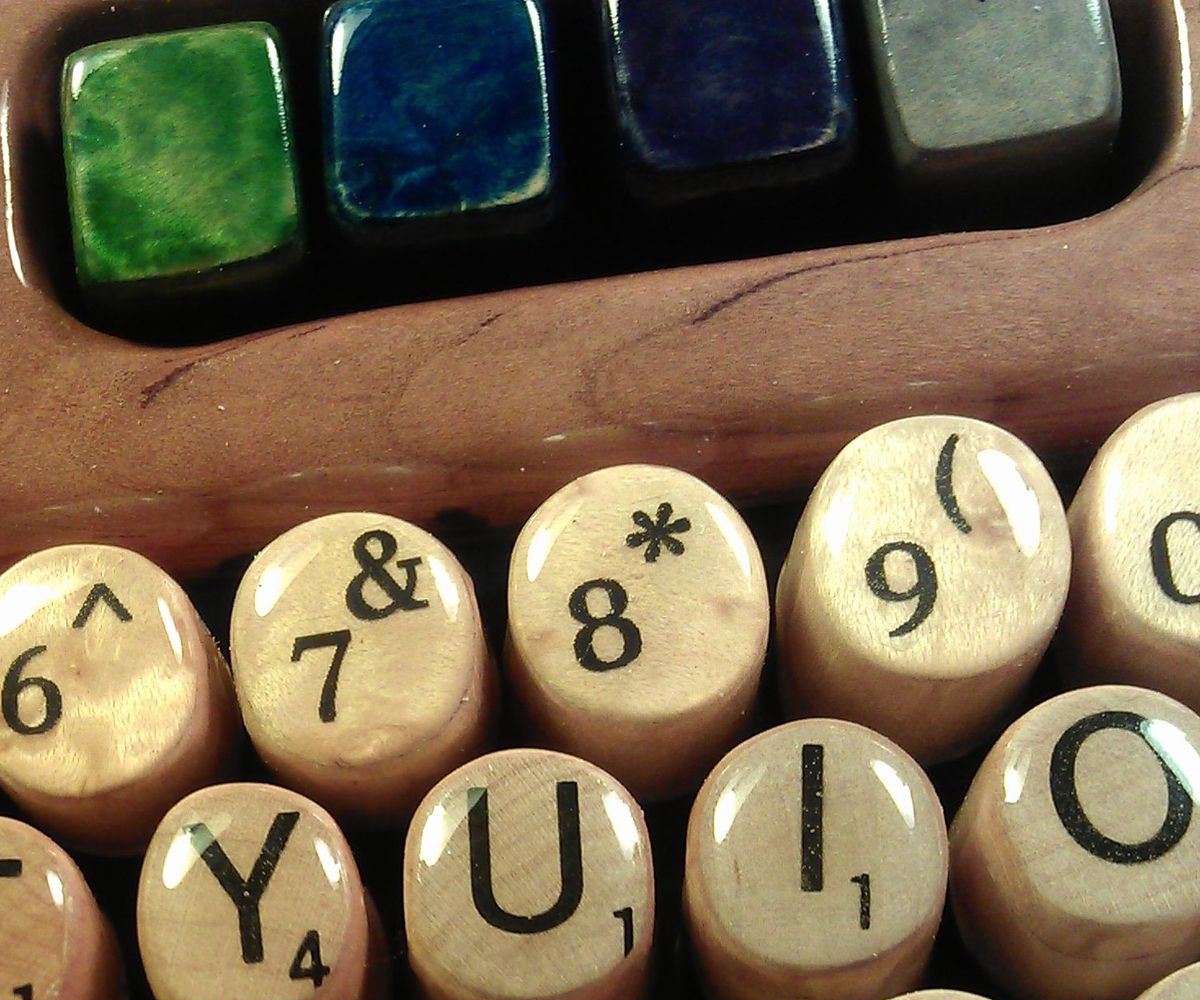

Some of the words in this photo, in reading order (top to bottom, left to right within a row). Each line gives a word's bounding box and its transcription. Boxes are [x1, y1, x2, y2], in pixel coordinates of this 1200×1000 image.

[937, 433, 973, 535] (
[72, 583, 133, 629] ^
[345, 529, 429, 621] &
[865, 541, 938, 638] 9
[568, 578, 642, 672] 8
[1, 645, 62, 735] 6
[291, 629, 352, 723] 7
[1049, 710, 1195, 865] O
[467, 781, 584, 935] U
[613, 906, 634, 958] 1
[801, 744, 824, 893] I
[851, 873, 871, 931] 1
[188, 811, 300, 964] Y
[289, 930, 330, 988] 4
